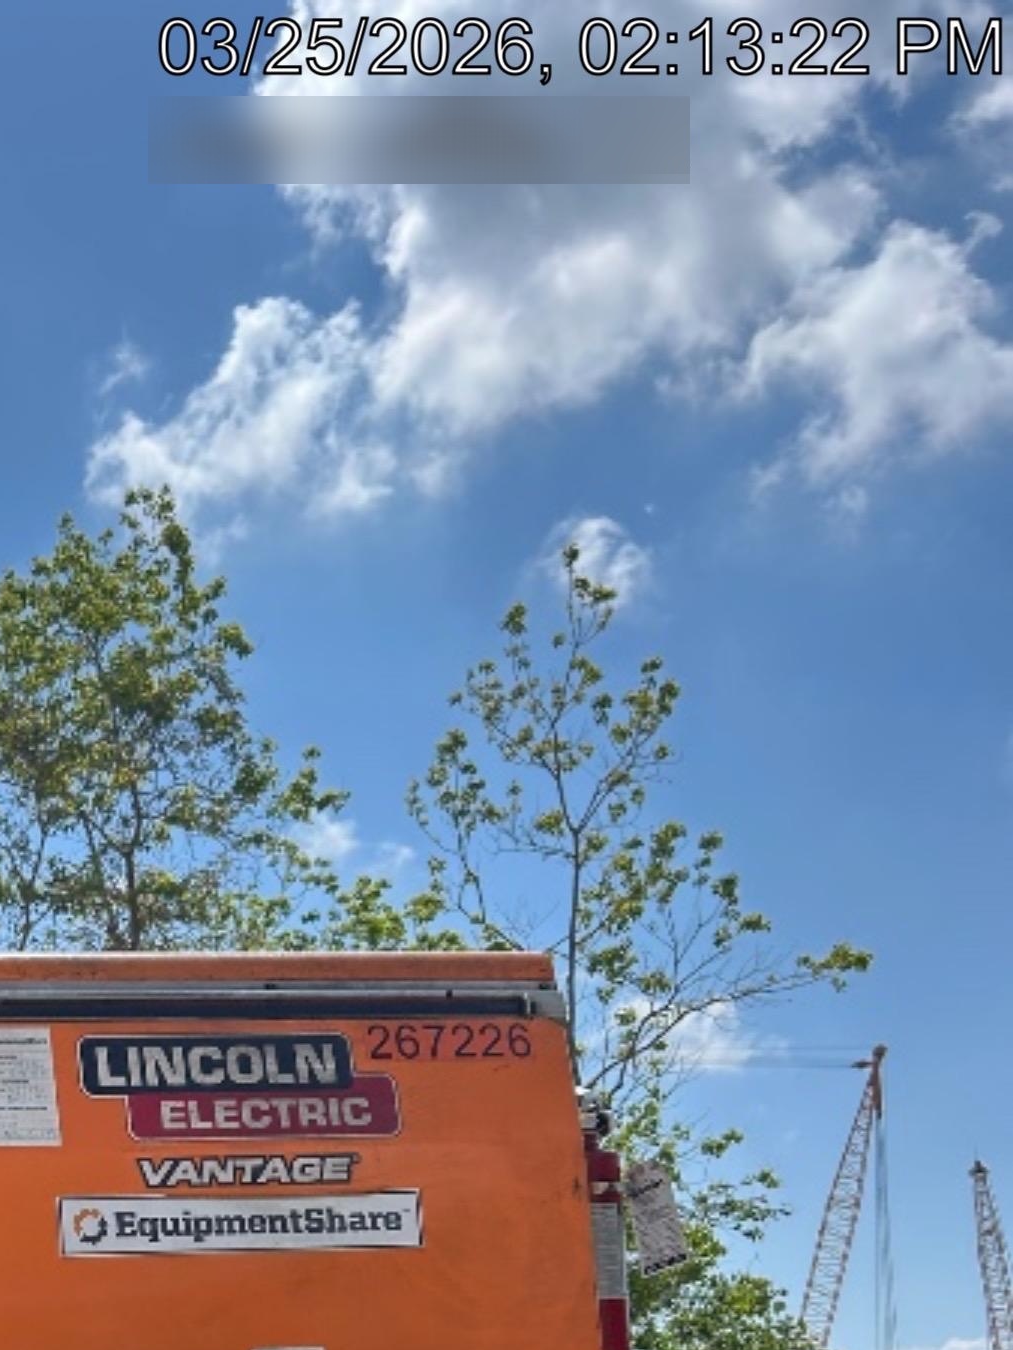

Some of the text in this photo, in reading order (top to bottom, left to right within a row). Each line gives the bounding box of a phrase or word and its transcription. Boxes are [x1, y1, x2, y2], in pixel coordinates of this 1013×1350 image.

[367, 1023, 532, 1060] 267226
[94, 1043, 338, 1087] LINCOLN
[160, 1097, 372, 1130] ELECTRIC
[138, 1155, 353, 1187] VANTAGE
[115, 1207, 402, 1242] EquipmentShare
